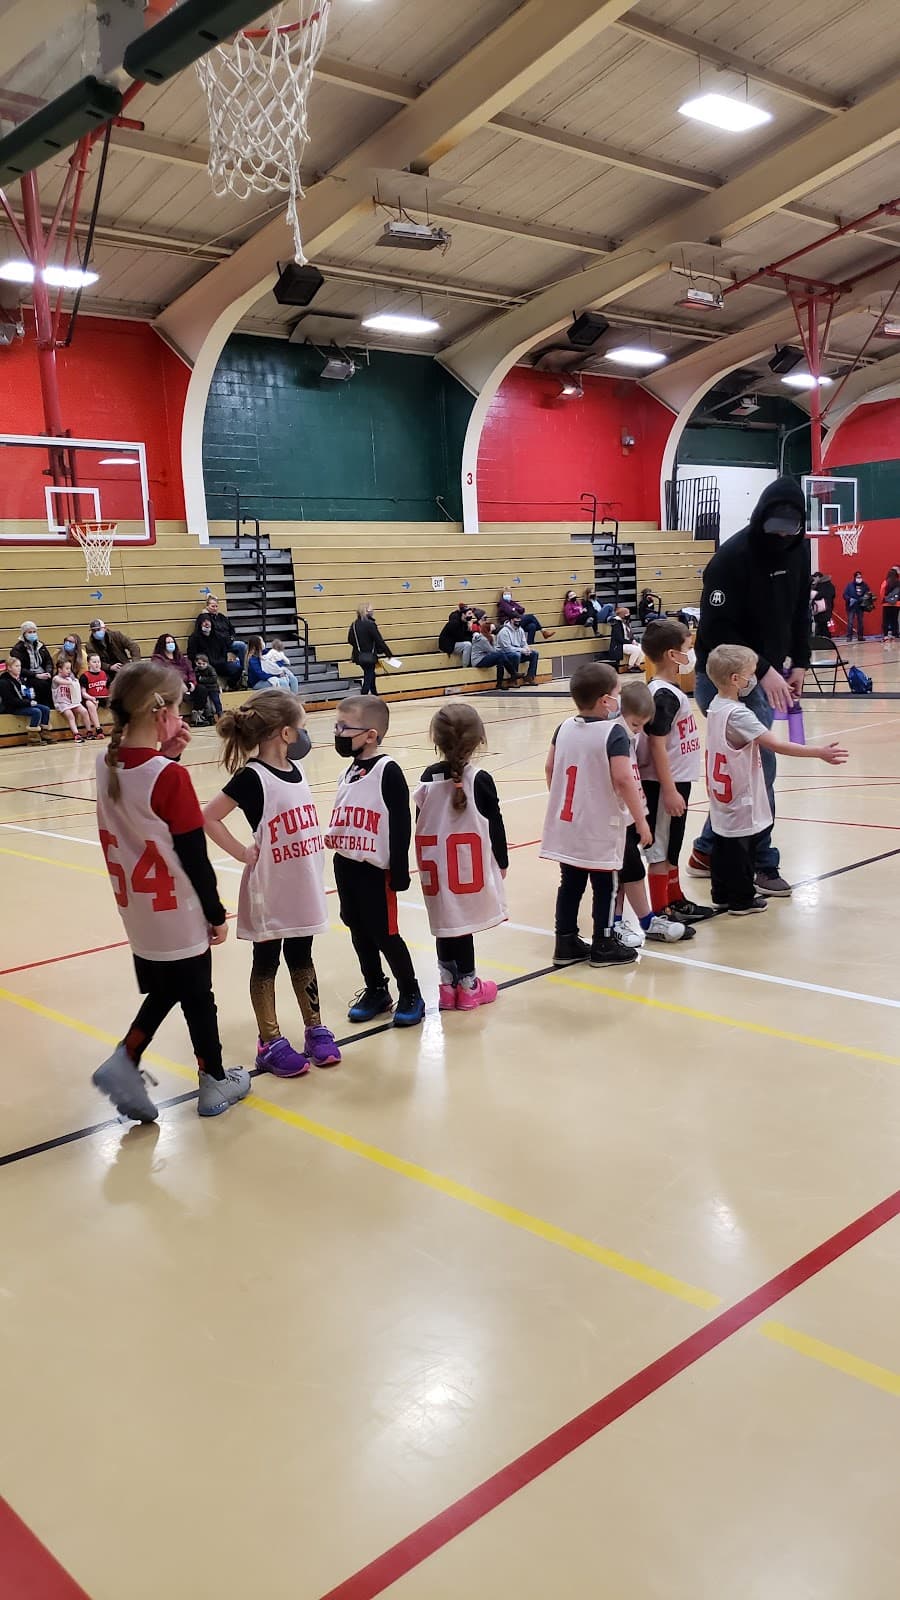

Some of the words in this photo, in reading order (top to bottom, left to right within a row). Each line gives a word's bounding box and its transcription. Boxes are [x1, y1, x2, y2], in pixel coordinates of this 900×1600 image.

[467, 472, 473, 485] 3
[560, 765, 578, 822] 1
[415, 832, 485, 897] 50
